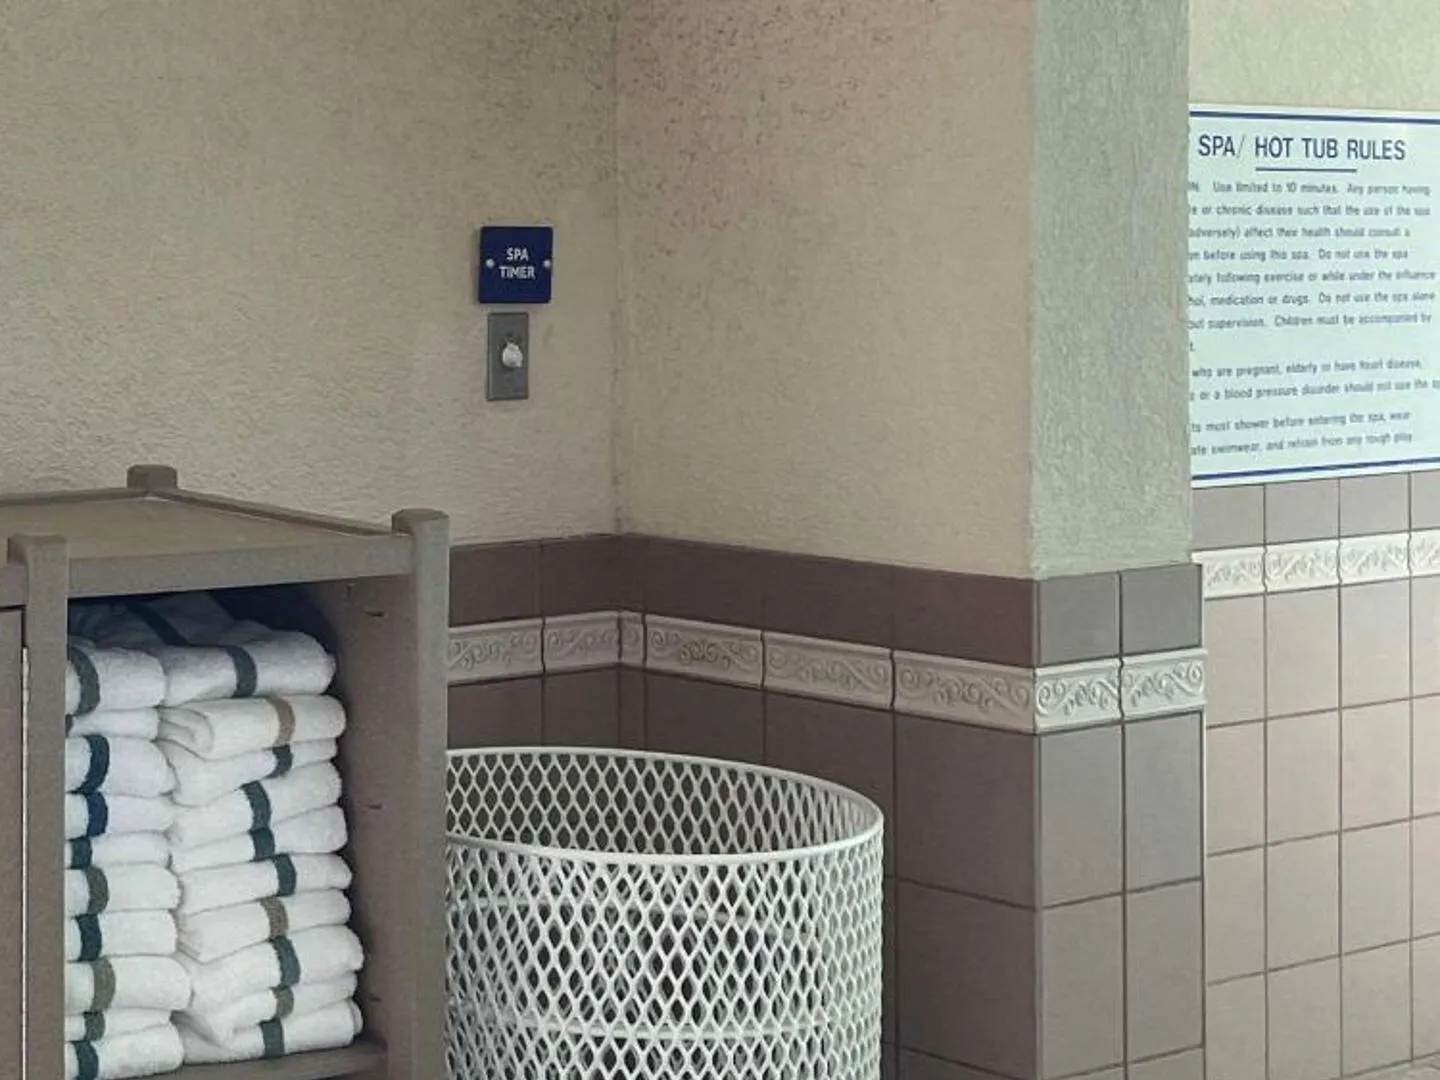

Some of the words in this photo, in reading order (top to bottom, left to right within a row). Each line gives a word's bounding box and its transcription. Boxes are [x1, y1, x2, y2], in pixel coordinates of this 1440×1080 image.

[1255, 136, 1293, 159] HOT
[1302, 137, 1339, 160] TUB
[1347, 138, 1406, 161] RULES
[1212, 182, 1232, 193] Use
[1236, 182, 1268, 193] limited
[1272, 183, 1283, 193] to
[1286, 182, 1297, 193] 10
[1367, 185, 1399, 196] person
[1401, 184, 1431, 197] having
[1216, 204, 1252, 216] chronic
[1256, 205, 1292, 216] disease
[1296, 205, 1319, 216] such
[1323, 204, 1341, 216] that
[1345, 204, 1360, 216] the
[1363, 206, 1380, 216] use
[1384, 205, 1393, 216] of
[1396, 205, 1411, 216] the
[1413, 206, 1431, 217] spa
[1244, 226, 1273, 238] affect
[1301, 227, 1332, 238] health
[1334, 227, 1365, 238] should
[1368, 228, 1401, 238] consult
[506, 247, 528, 262] SPA
[1203, 249, 1236, 261] before
[1239, 250, 1266, 263] using
[1270, 249, 1288, 261] this
[1318, 249, 1332, 260] Do
[1335, 250, 1351, 260] not
[1353, 250, 1370, 260] use
[1374, 249, 1388, 260] the
[499, 265, 535, 279] TIMER
[1216, 271, 1260, 286] following
[1264, 272, 1304, 283] exercise
[1322, 269, 1345, 281] while
[1349, 271, 1375, 281] under
[1378, 270, 1392, 280] the
[1396, 269, 1436, 280] influence
[1210, 294, 1264, 306] medication
[1267, 295, 1278, 304] or
[1318, 292, 1331, 304] Do
[1335, 292, 1351, 303] not
[1353, 293, 1371, 303] use
[1374, 291, 1388, 302] the
[1392, 293, 1408, 304] spa
[1412, 291, 1436, 301] alone
[1274, 314, 1314, 327] Children
[1316, 316, 1339, 325] must
[1343, 314, 1355, 325] be
[1358, 313, 1418, 325] accompanied
[1421, 312, 1433, 325] by
[1192, 367, 1213, 377] who
[1216, 368, 1233, 377] are
[1286, 362, 1318, 376] elderly
[1334, 361, 1356, 371] have
[1359, 359, 1383, 370] heart
[1224, 387, 1253, 399] blood
[1256, 386, 1298, 399] pressure
[1301, 383, 1340, 395] disorder
[1344, 381, 1374, 392] should
[1376, 381, 1391, 391] not
[1394, 381, 1411, 390] use
[1413, 378, 1428, 389] the
[1205, 420, 1230, 431] must
[1234, 418, 1270, 430] shower
[1273, 416, 1304, 428] before
[1308, 415, 1346, 428] entering
[1349, 412, 1364, 423] the
[1389, 411, 1410, 420] wear
[1266, 441, 1284, 451] and
[1288, 438, 1318, 448] refrain
[1321, 436, 1343, 446] from
[1346, 436, 1363, 447] any
[1365, 434, 1391, 446] rough
